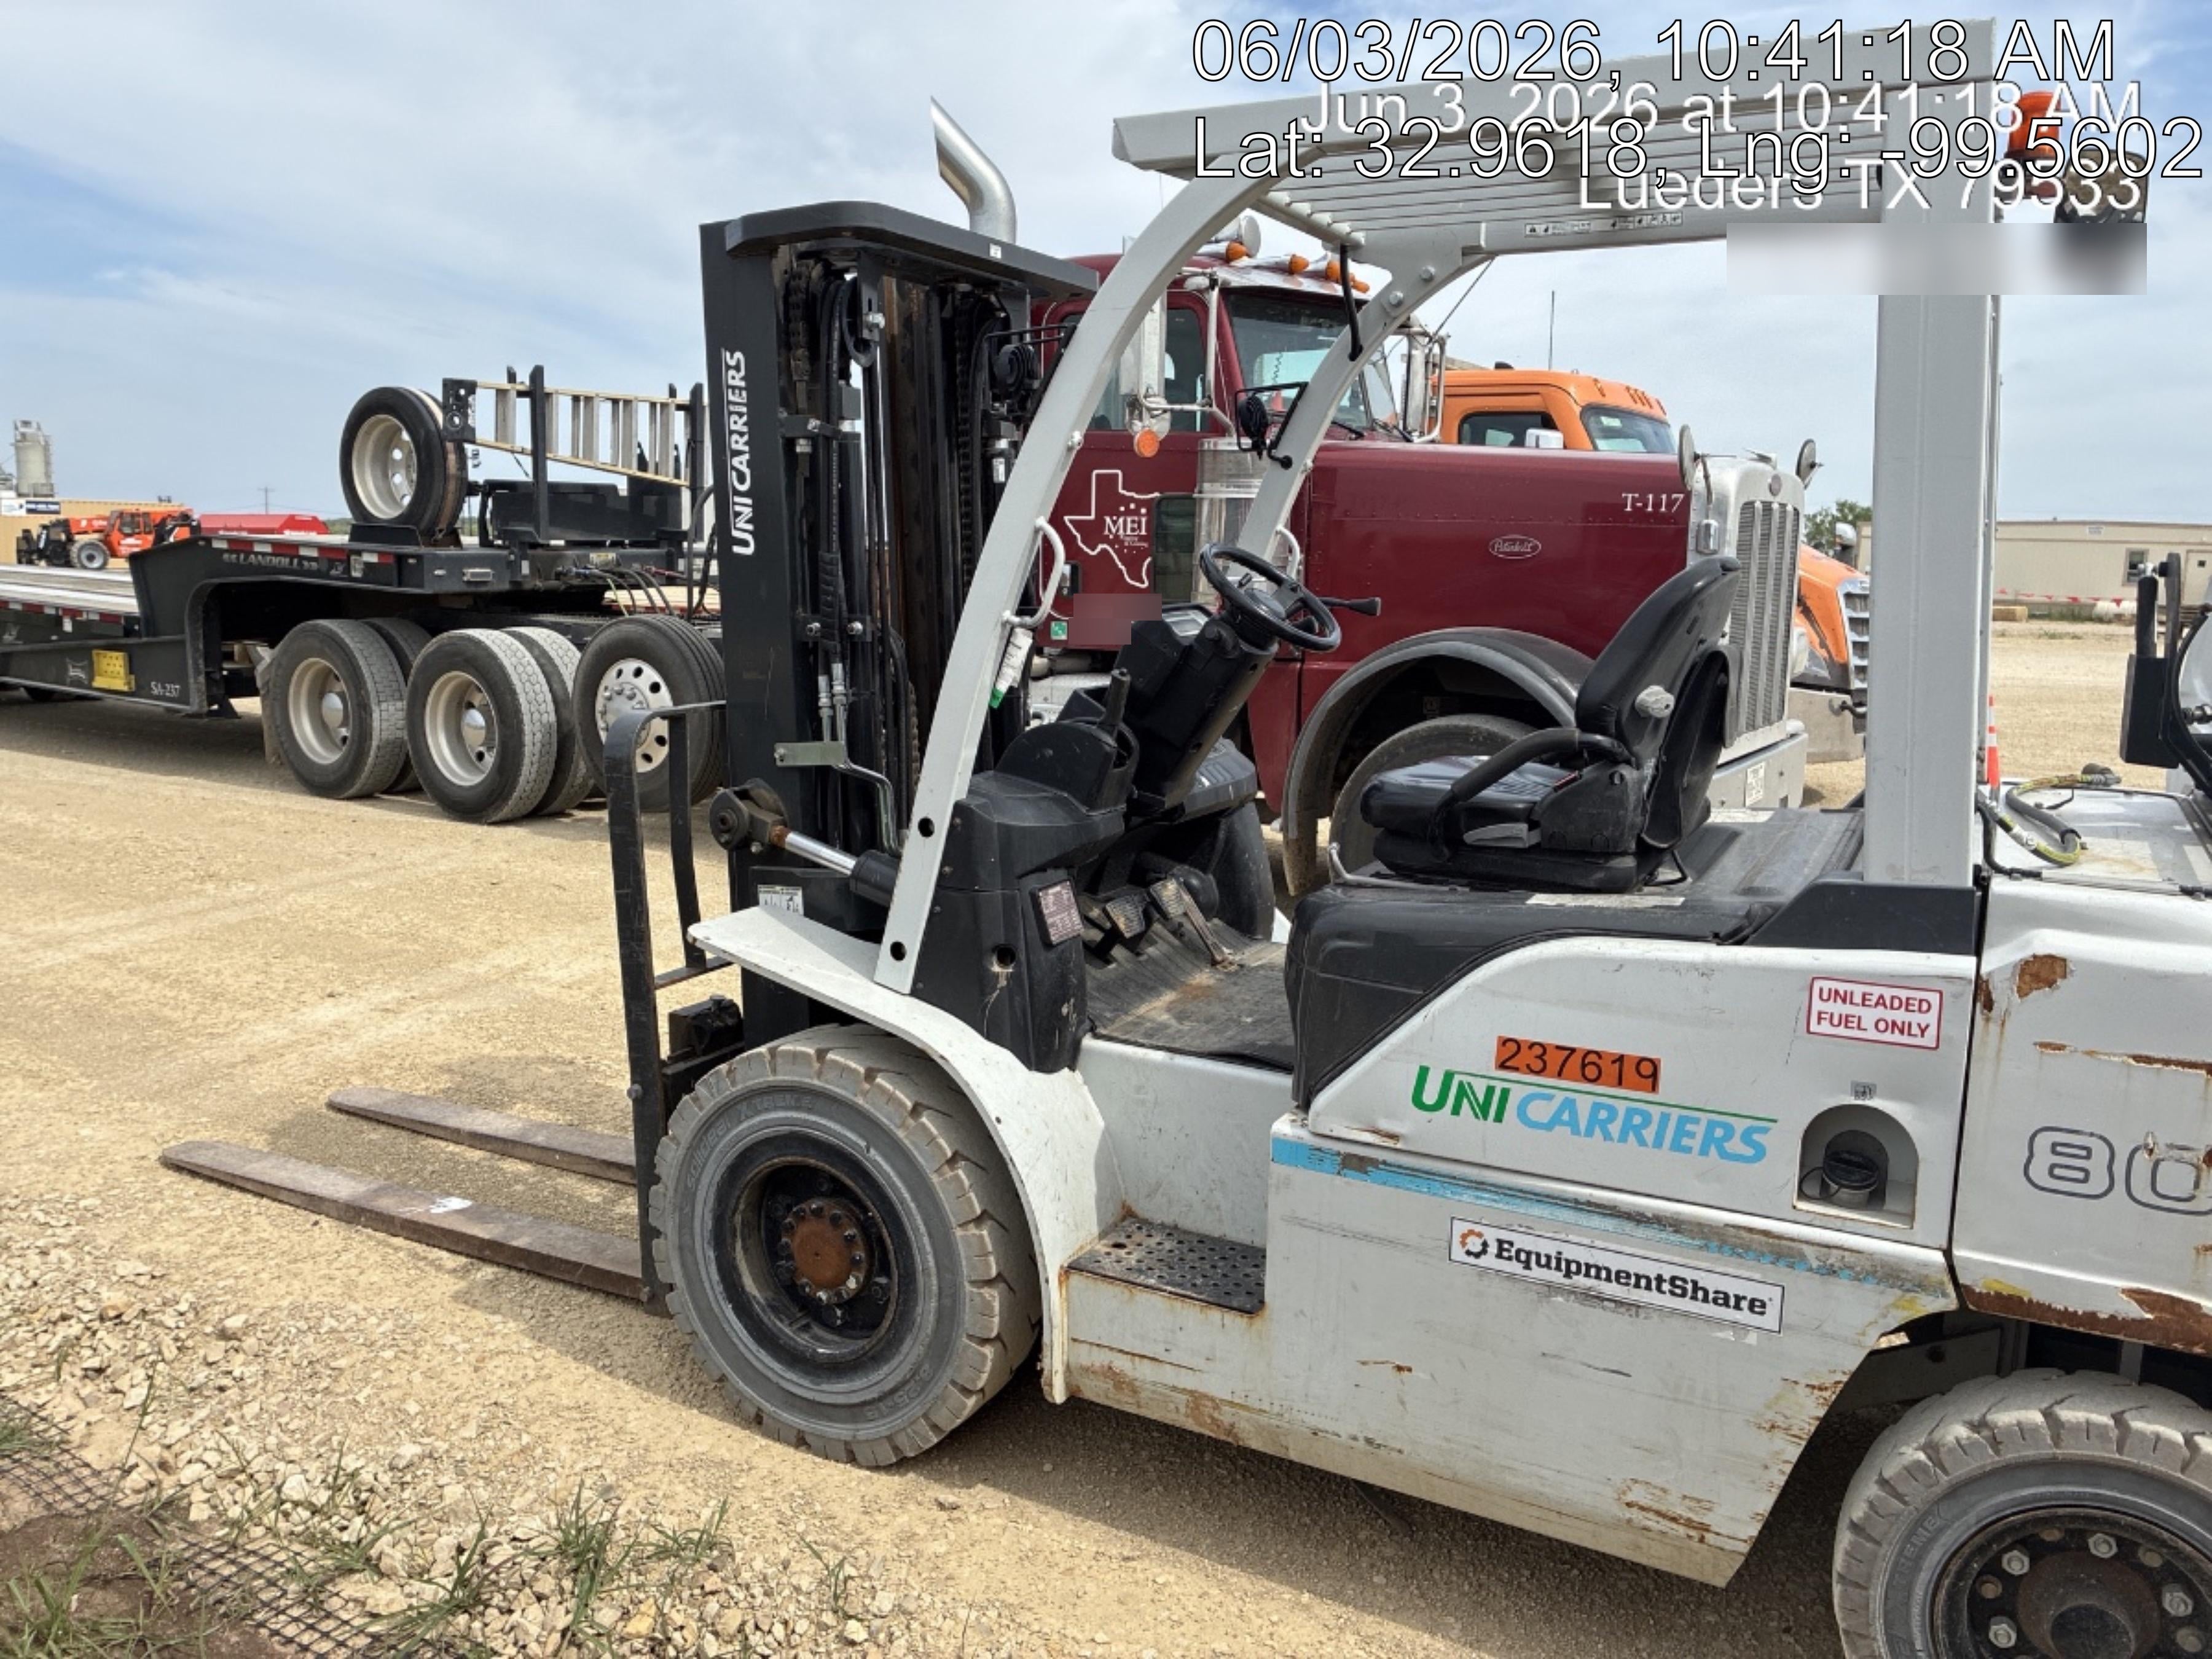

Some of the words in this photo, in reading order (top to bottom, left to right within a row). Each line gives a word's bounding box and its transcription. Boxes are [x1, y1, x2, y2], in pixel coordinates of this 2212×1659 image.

[1621, 493, 1685, 513] T-117
[1102, 516, 1148, 536] MEI
[1819, 986, 1932, 1014] UNLEADED
[1817, 1010, 1868, 1032] FUEL
[1874, 1017, 1931, 1038] ONLY
[1497, 1037, 1659, 1092] 237619
[1494, 1237, 1768, 1316] EquipmentShare
